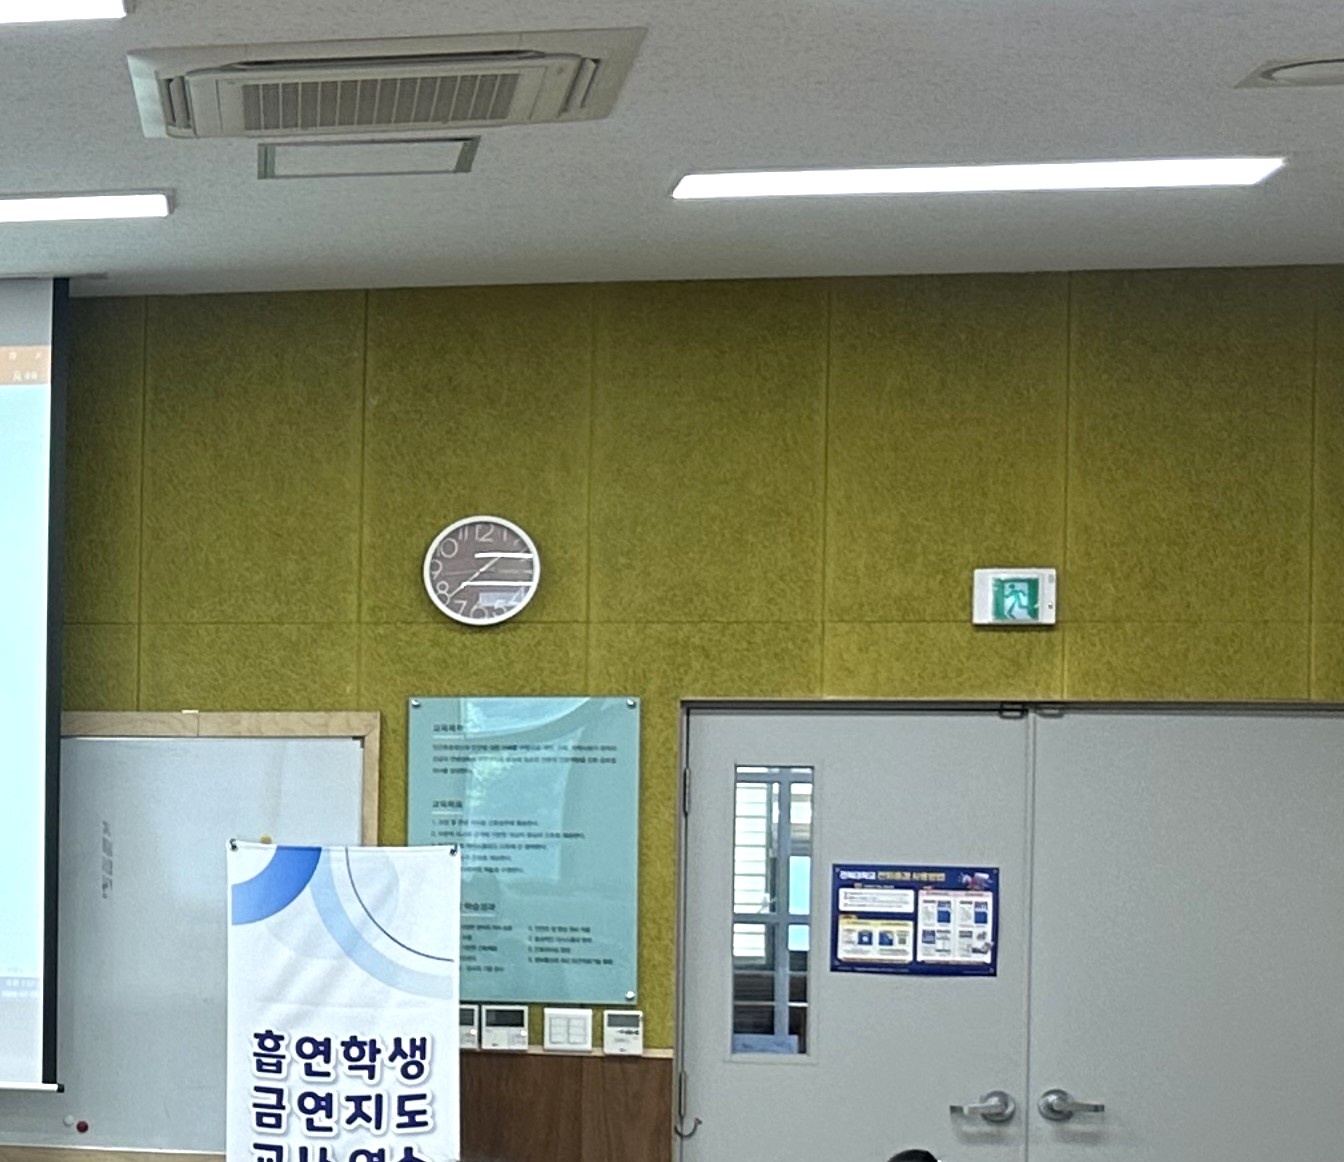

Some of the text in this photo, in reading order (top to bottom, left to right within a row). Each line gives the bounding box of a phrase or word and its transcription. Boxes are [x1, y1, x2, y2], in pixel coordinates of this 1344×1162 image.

[475, 524, 494, 542] 12
[252, 1029, 429, 1081] 흡연학생
[252, 1085, 430, 1133] 금연지도
